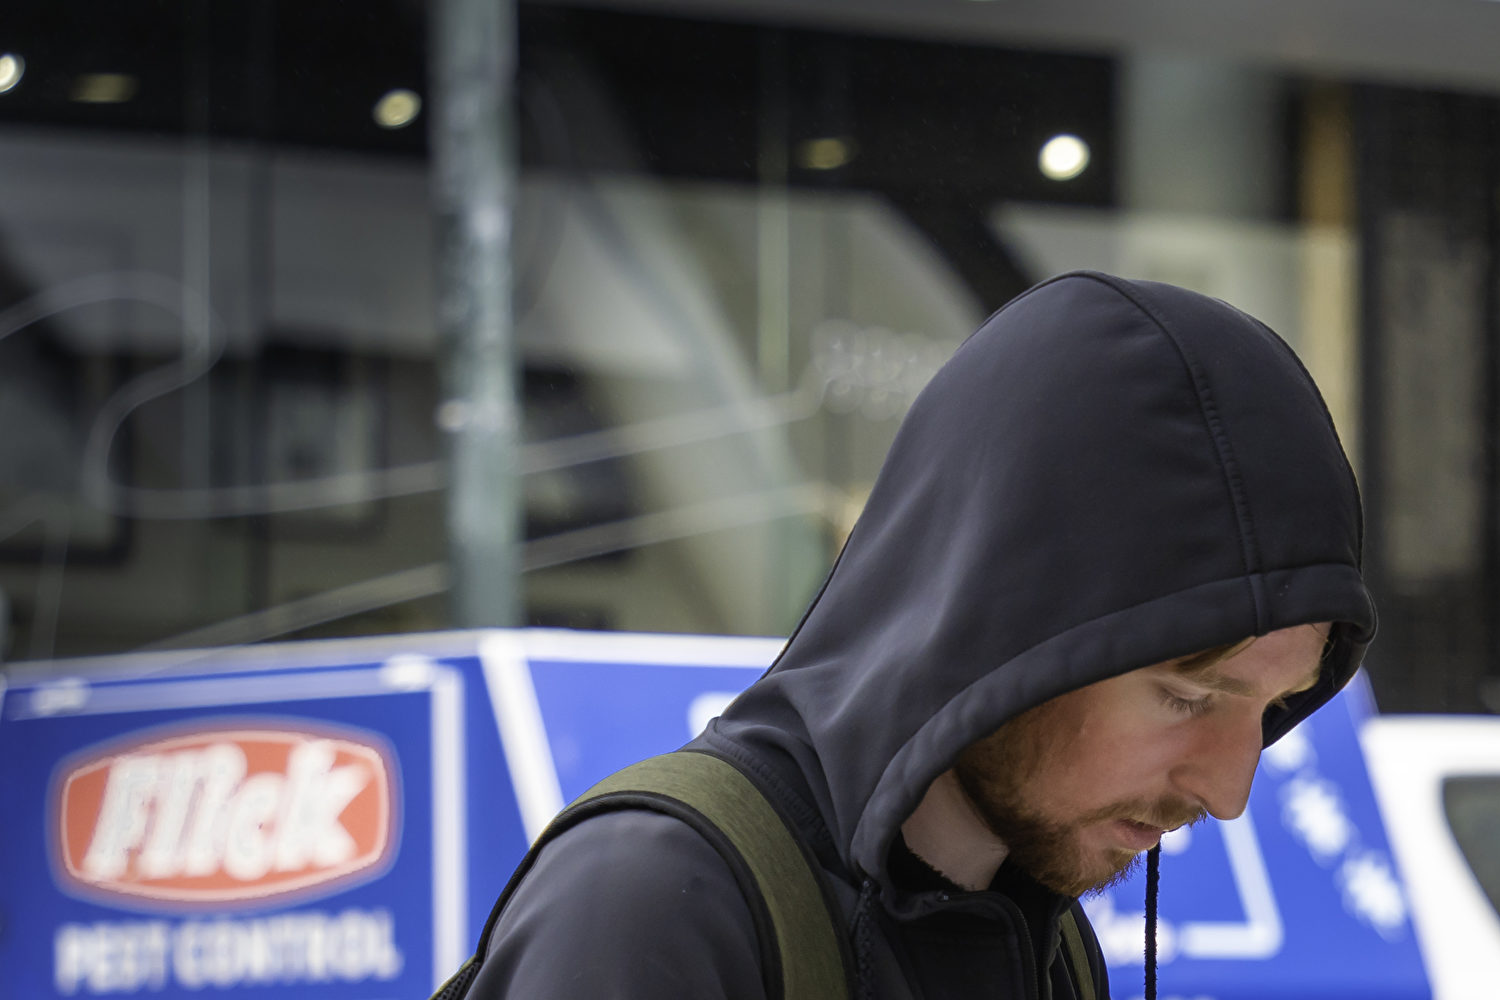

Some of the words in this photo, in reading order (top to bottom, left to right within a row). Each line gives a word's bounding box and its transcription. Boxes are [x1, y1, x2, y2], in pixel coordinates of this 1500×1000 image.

[80, 740, 374, 882] Flick
[55, 920, 167, 995] PEST
[174, 909, 403, 990] CONTROL
